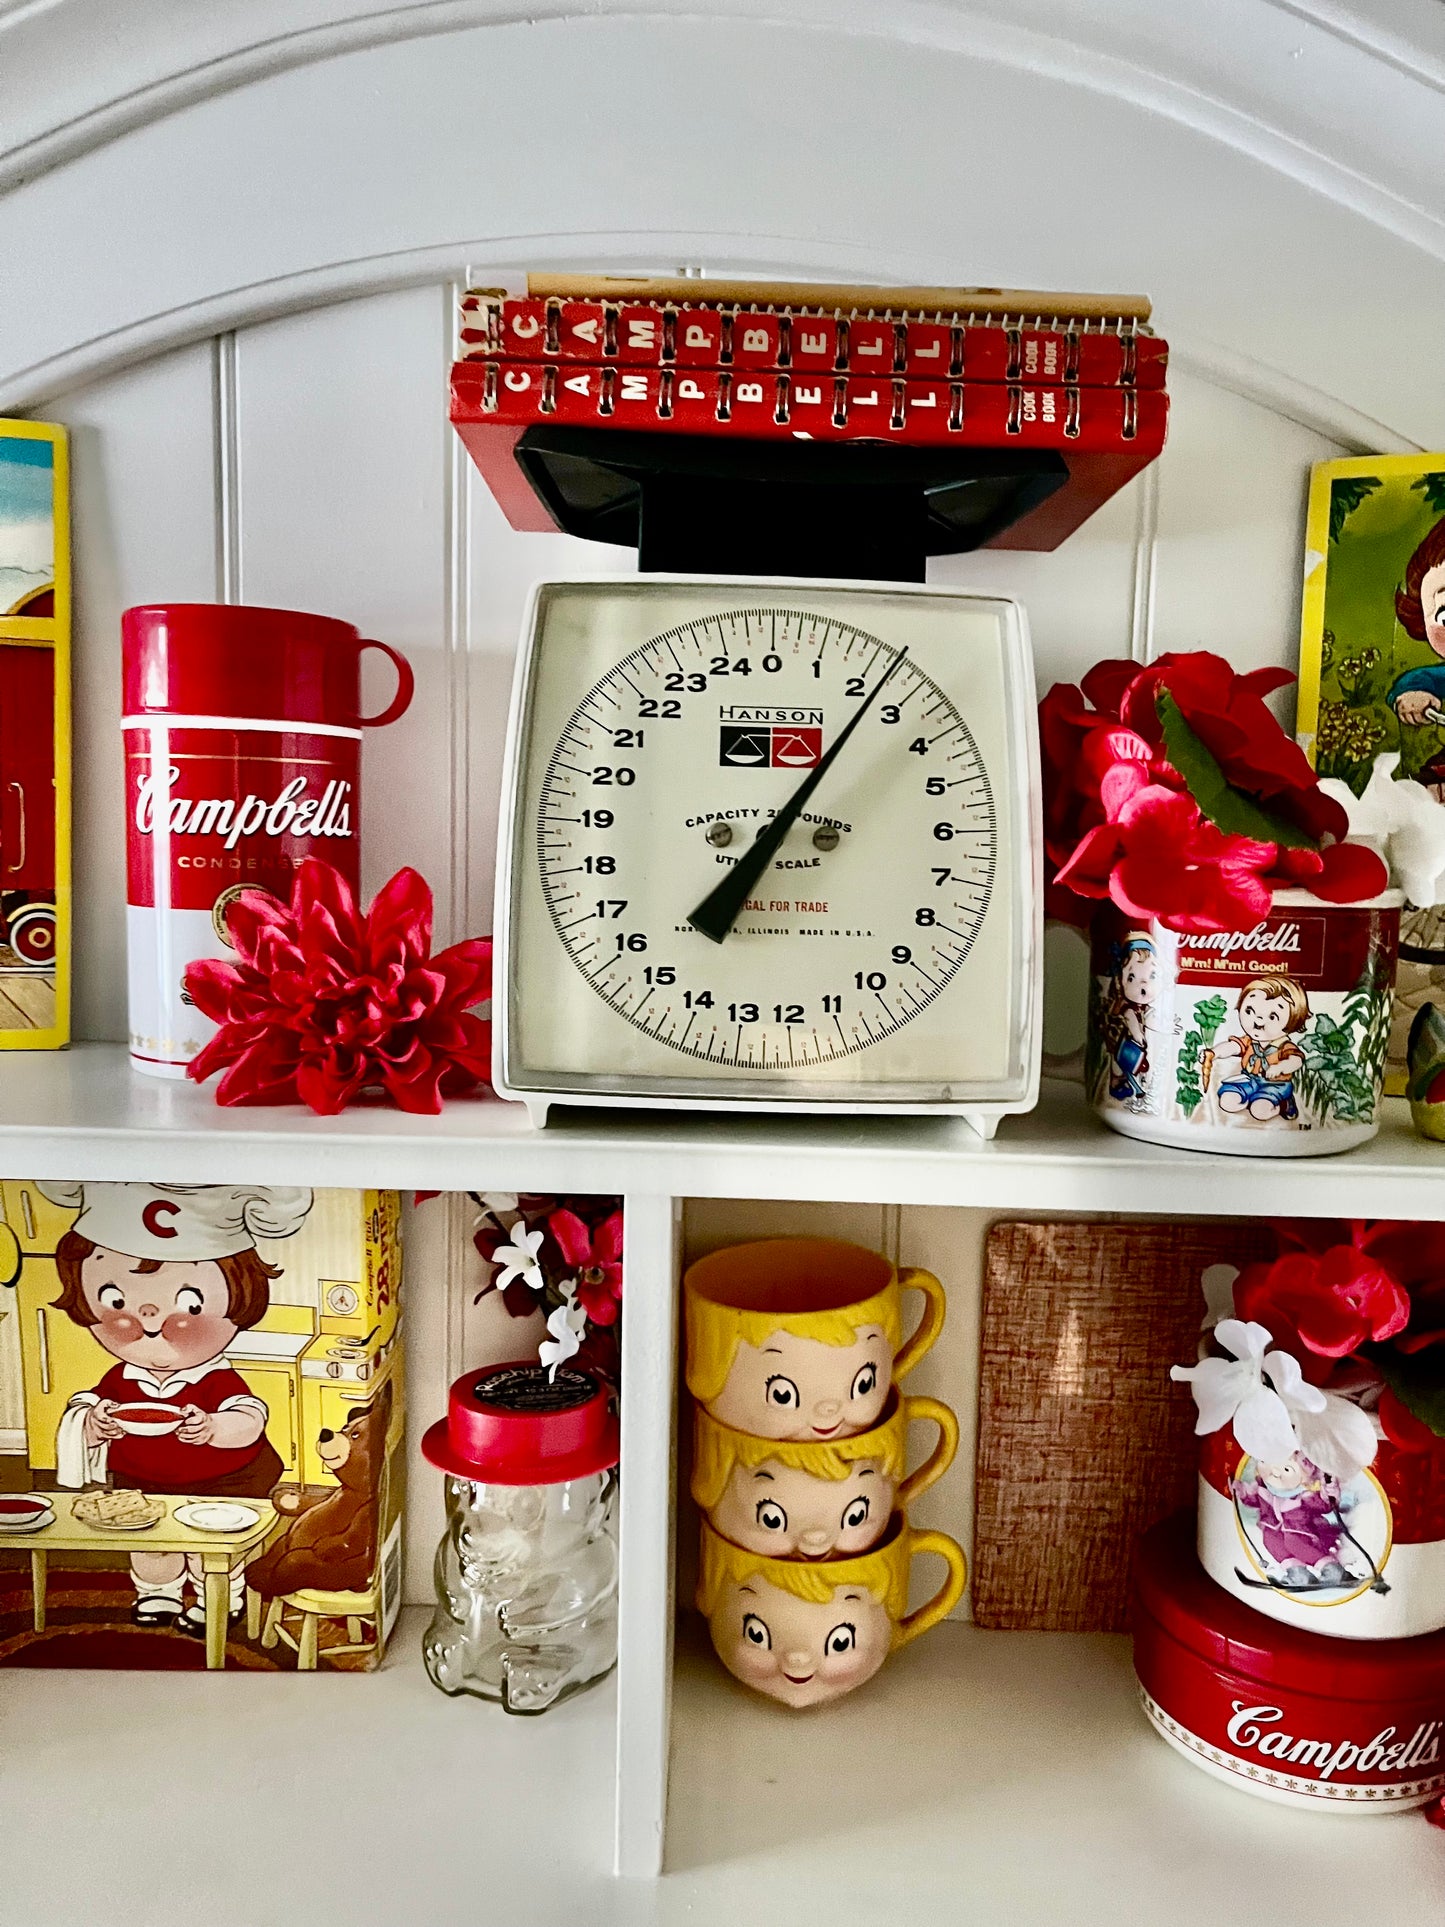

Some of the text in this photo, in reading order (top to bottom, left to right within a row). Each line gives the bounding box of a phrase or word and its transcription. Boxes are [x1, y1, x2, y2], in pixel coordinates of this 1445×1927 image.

[1025, 340, 1038, 374] COOK
[1044, 340, 1057, 375] BOOK
[1023, 391, 1036, 422] COOK
[1042, 392, 1055, 423] BOOK
[709, 657, 752, 676] 24
[762, 654, 783, 673] 0
[812, 661, 820, 678] 1
[664, 673, 708, 692] 23
[845, 678, 865, 696] 2
[638, 699, 682, 719] 22
[719, 706, 824, 724] HANSON
[881, 705, 900, 724] 3
[613, 729, 644, 748] 21
[909, 738, 928, 755] 4
[592, 767, 636, 786] 20
[926, 777, 945, 796] 5
[136, 765, 352, 849] Campbell's
[582, 810, 614, 828] 19
[685, 809, 760, 828] CAPACITY
[797, 812, 853, 833] OUNDS
[933, 822, 954, 841] 6
[584, 856, 616, 875] 18
[775, 858, 821, 870] SCALE
[931, 868, 951, 886] 7
[596, 900, 628, 918] 17
[741, 900, 829, 912] GAL FOR TRADE
[915, 908, 936, 927] 8
[748, 927, 789, 936] ILLINOIS
[615, 933, 648, 952] 16
[891, 945, 912, 964] 9
[1181, 957, 1289, 973] M'm! M'm! Good!
[643, 966, 676, 985] 15
[854, 972, 887, 990] 10
[683, 991, 715, 1009] 14
[821, 995, 841, 1013] 11
[728, 1003, 760, 1023] 13
[773, 1005, 805, 1023] 12
[142, 1199, 182, 1239] C
[1226, 1700, 1444, 1779] Campbell's
